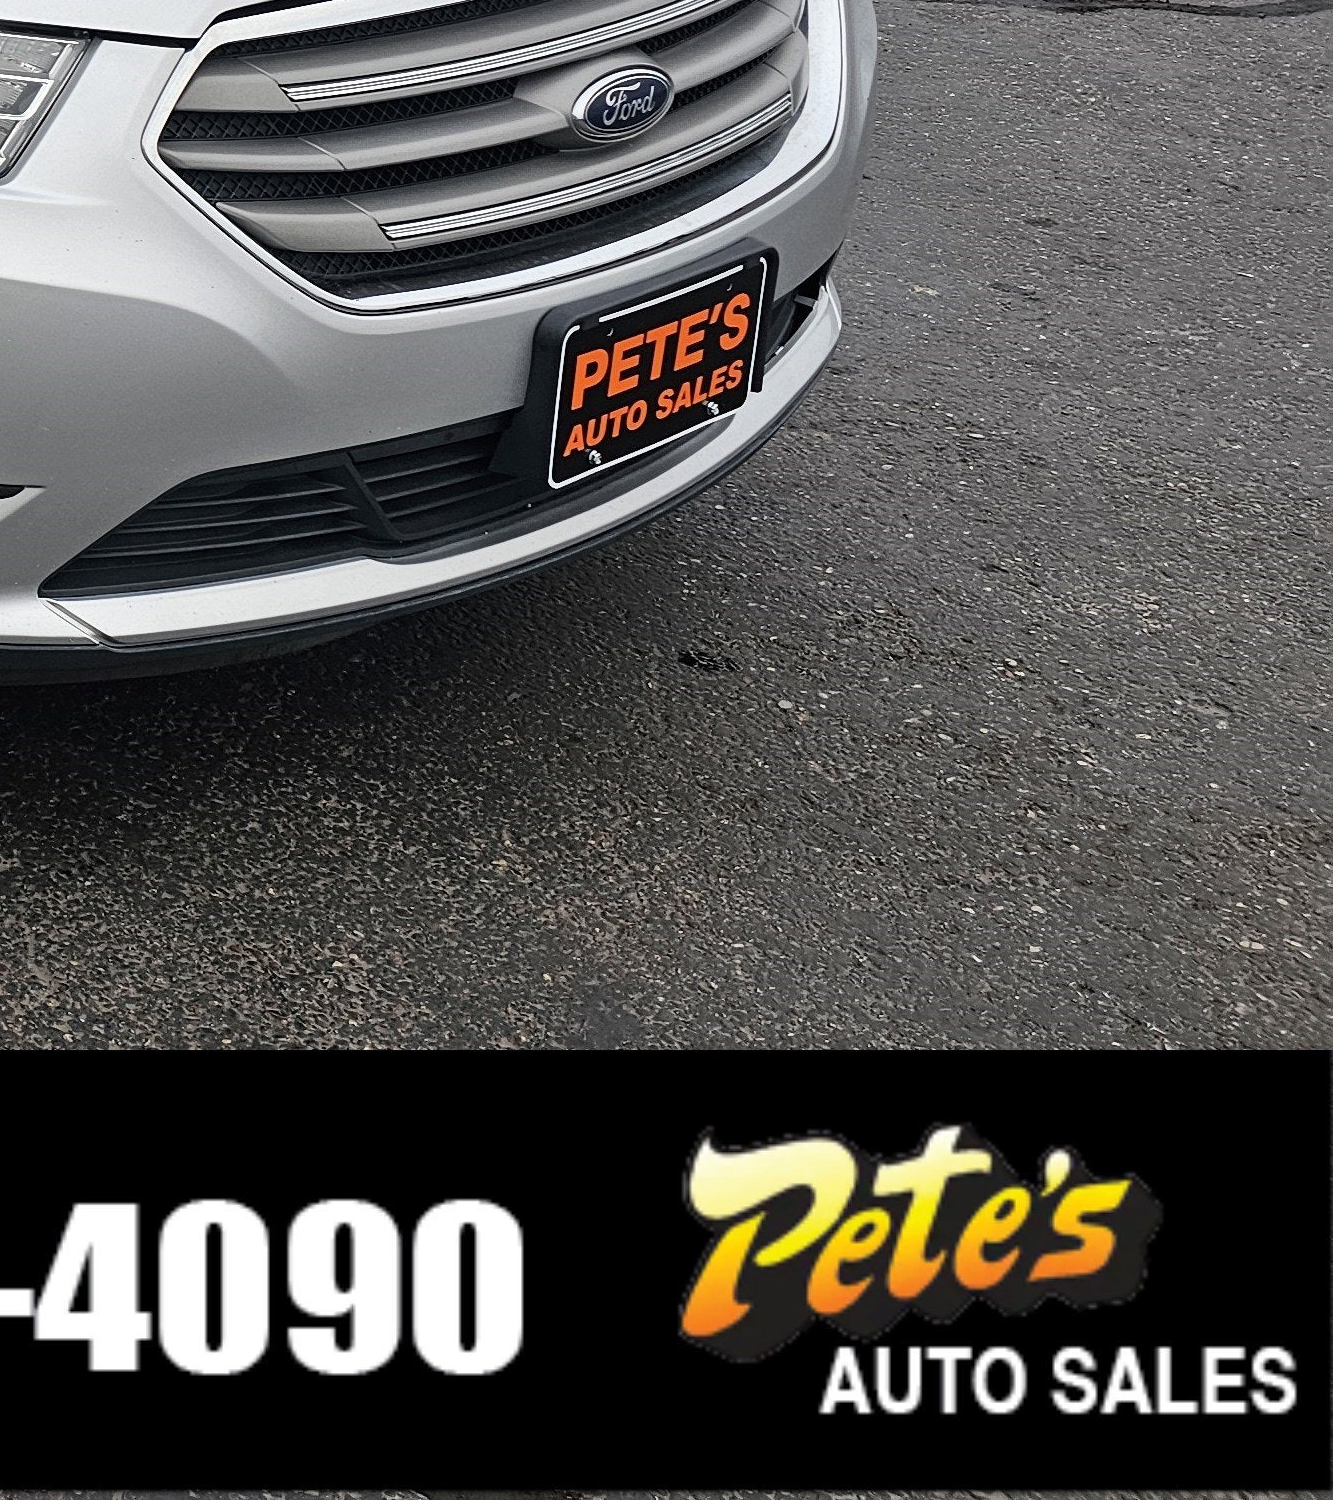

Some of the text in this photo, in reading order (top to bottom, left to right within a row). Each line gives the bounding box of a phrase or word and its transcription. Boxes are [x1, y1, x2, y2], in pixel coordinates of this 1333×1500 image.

[603, 82, 656, 126] Ford
[571, 293, 750, 411] PETE'S
[563, 359, 744, 457] AUTO SALES
